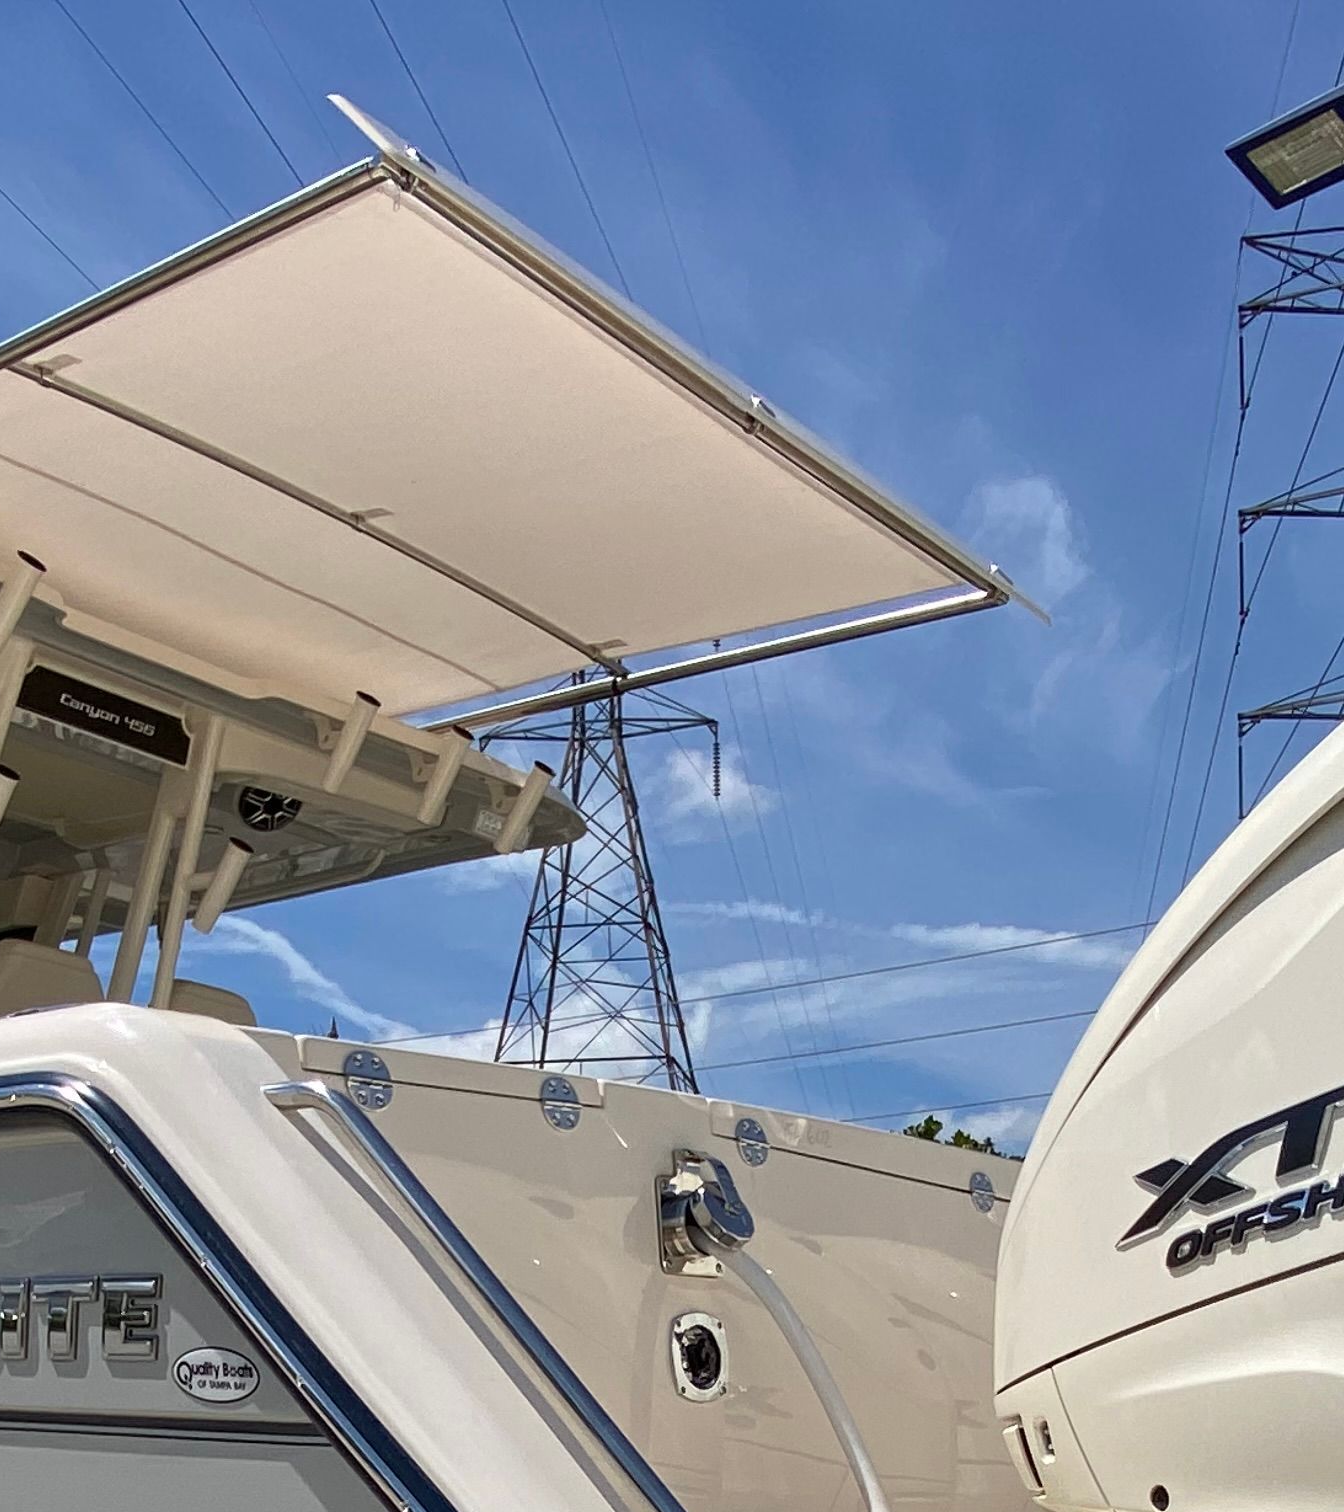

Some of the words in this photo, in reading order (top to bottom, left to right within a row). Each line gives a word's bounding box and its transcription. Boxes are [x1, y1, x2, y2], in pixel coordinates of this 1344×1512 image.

[59, 692, 121, 724] Canyon
[124, 715, 156, 737] 456
[176, 1361, 220, 1391] Quality
